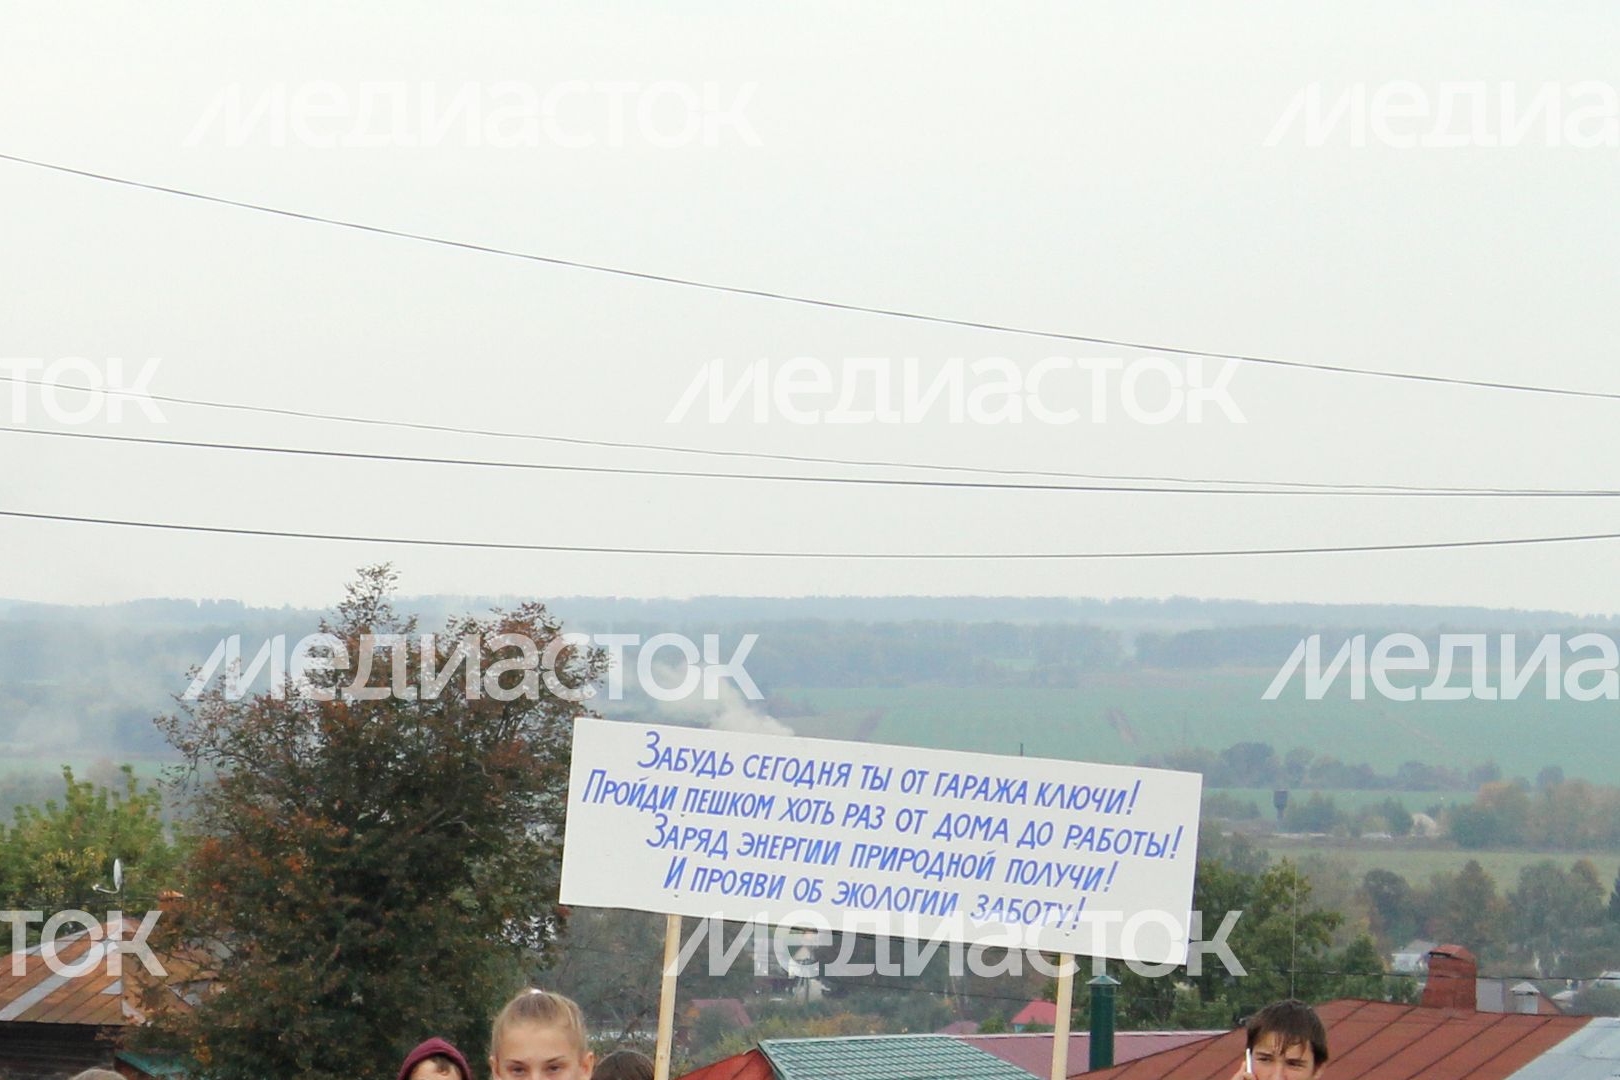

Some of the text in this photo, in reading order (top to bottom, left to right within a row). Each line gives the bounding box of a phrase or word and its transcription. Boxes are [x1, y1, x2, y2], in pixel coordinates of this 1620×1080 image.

[638, 732, 1141, 814] ЗАБУДЬ СЕГОДНЯ ТЫ ОТ ГАРАЖА КЛЮЧИ!
[584, 769, 1185, 858] ПРОЙДИ ПЕШКОМ ХОТЬ РАЗ ОТ ДОМА ДО РАБОТЫ!
[648, 813, 1118, 891] ЗАРЯД ЭНЕРГИИ ПРИРОДНОЙ ПОЛУЧИ!
[664, 858, 687, 888] И
[691, 867, 785, 897] ПРОЯВИ
[794, 878, 823, 903] ОБ
[833, 881, 957, 916] ЭКОЛОГИИ
